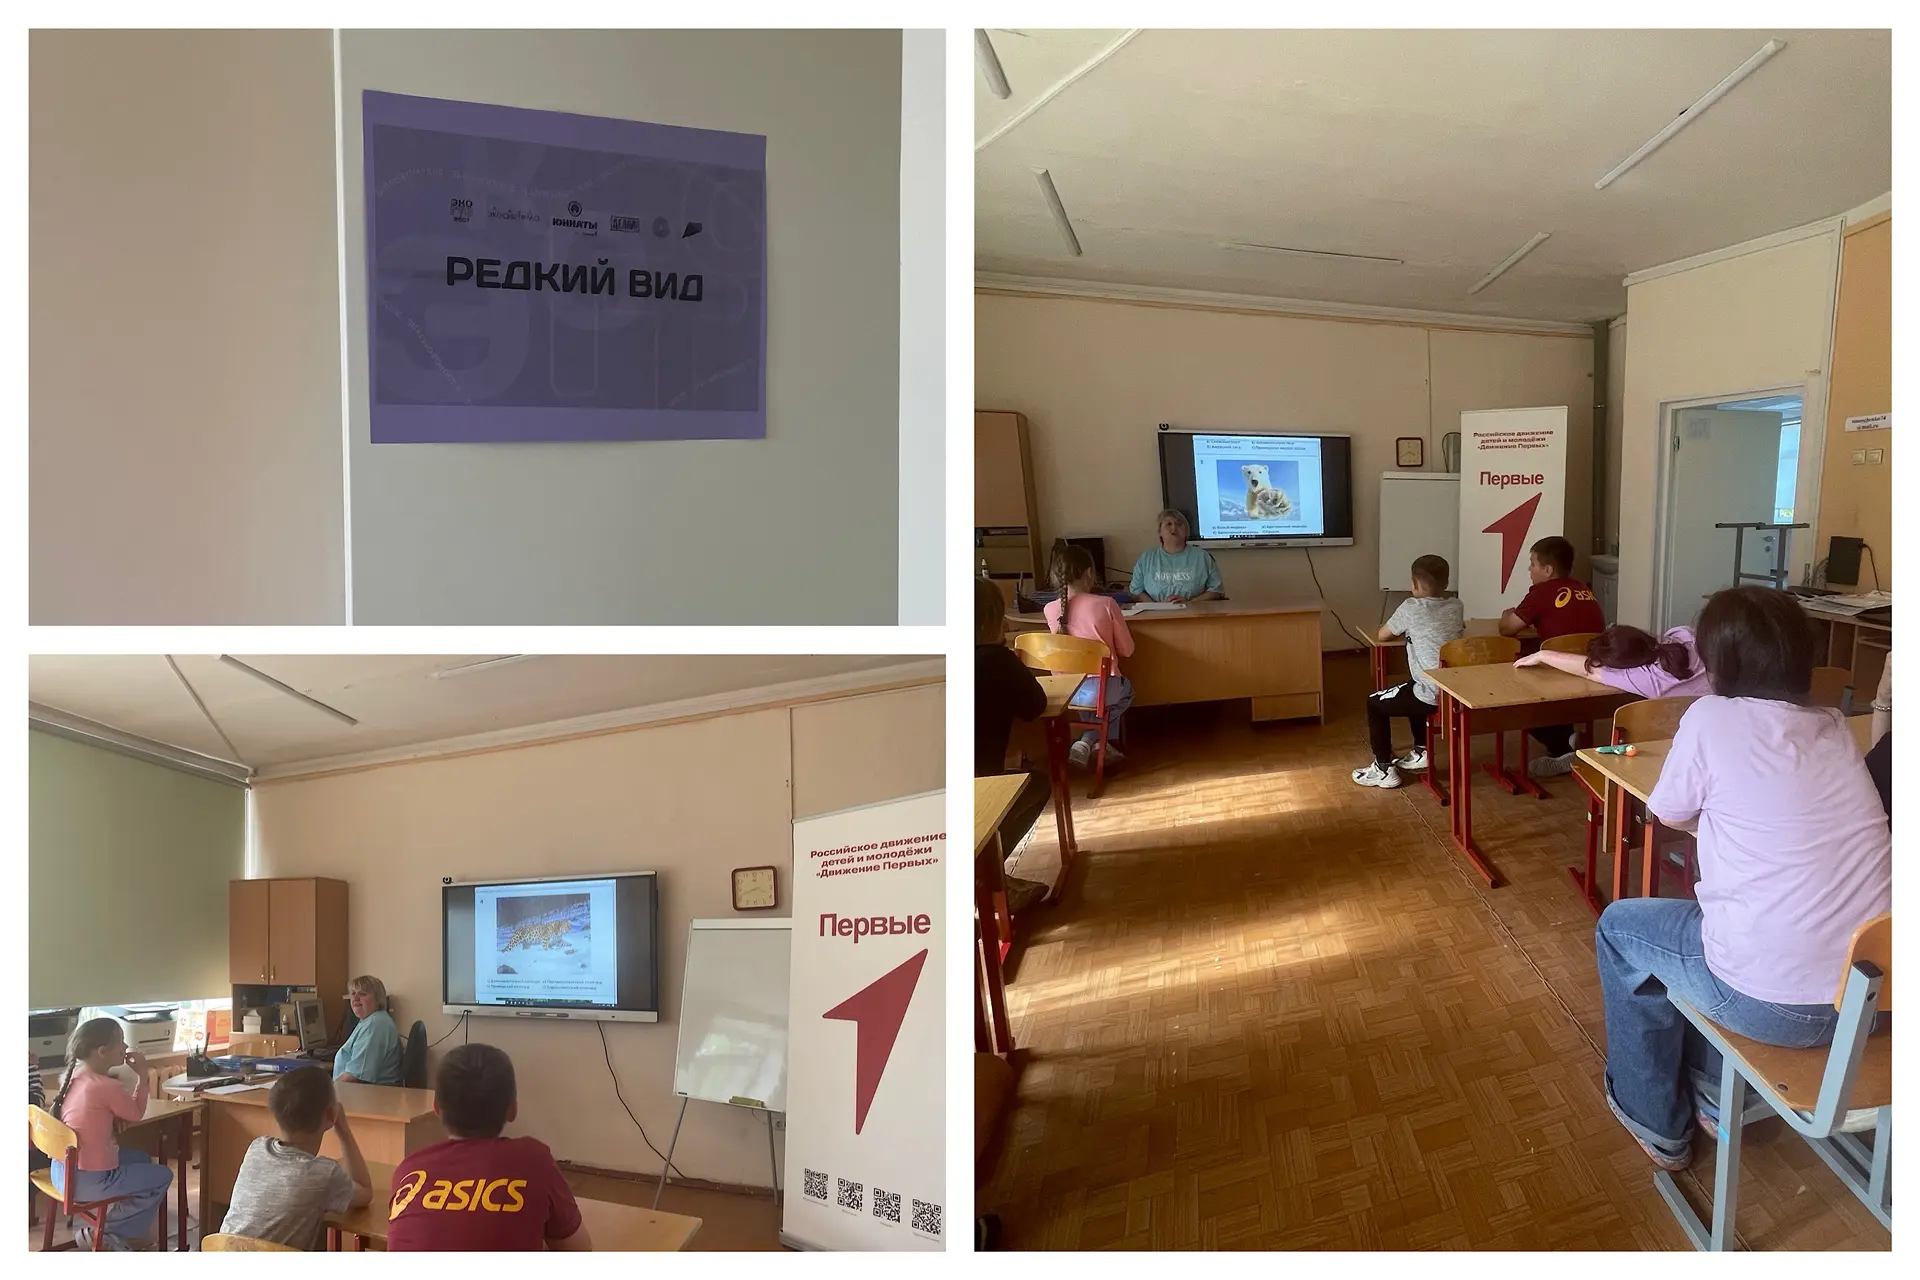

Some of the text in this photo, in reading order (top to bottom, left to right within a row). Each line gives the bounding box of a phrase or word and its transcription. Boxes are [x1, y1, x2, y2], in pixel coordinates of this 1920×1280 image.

[552, 217, 598, 230] ЮННАТЫ
[447, 256, 703, 302] РЕДКИЙ ВИД
[1480, 471, 1544, 489] Первые
[810, 832, 946, 859] Российское движение
[816, 858, 939, 878] «Движение Первых»
[821, 846, 932, 868] детей и молодёжи
[819, 913, 931, 944] Первые
